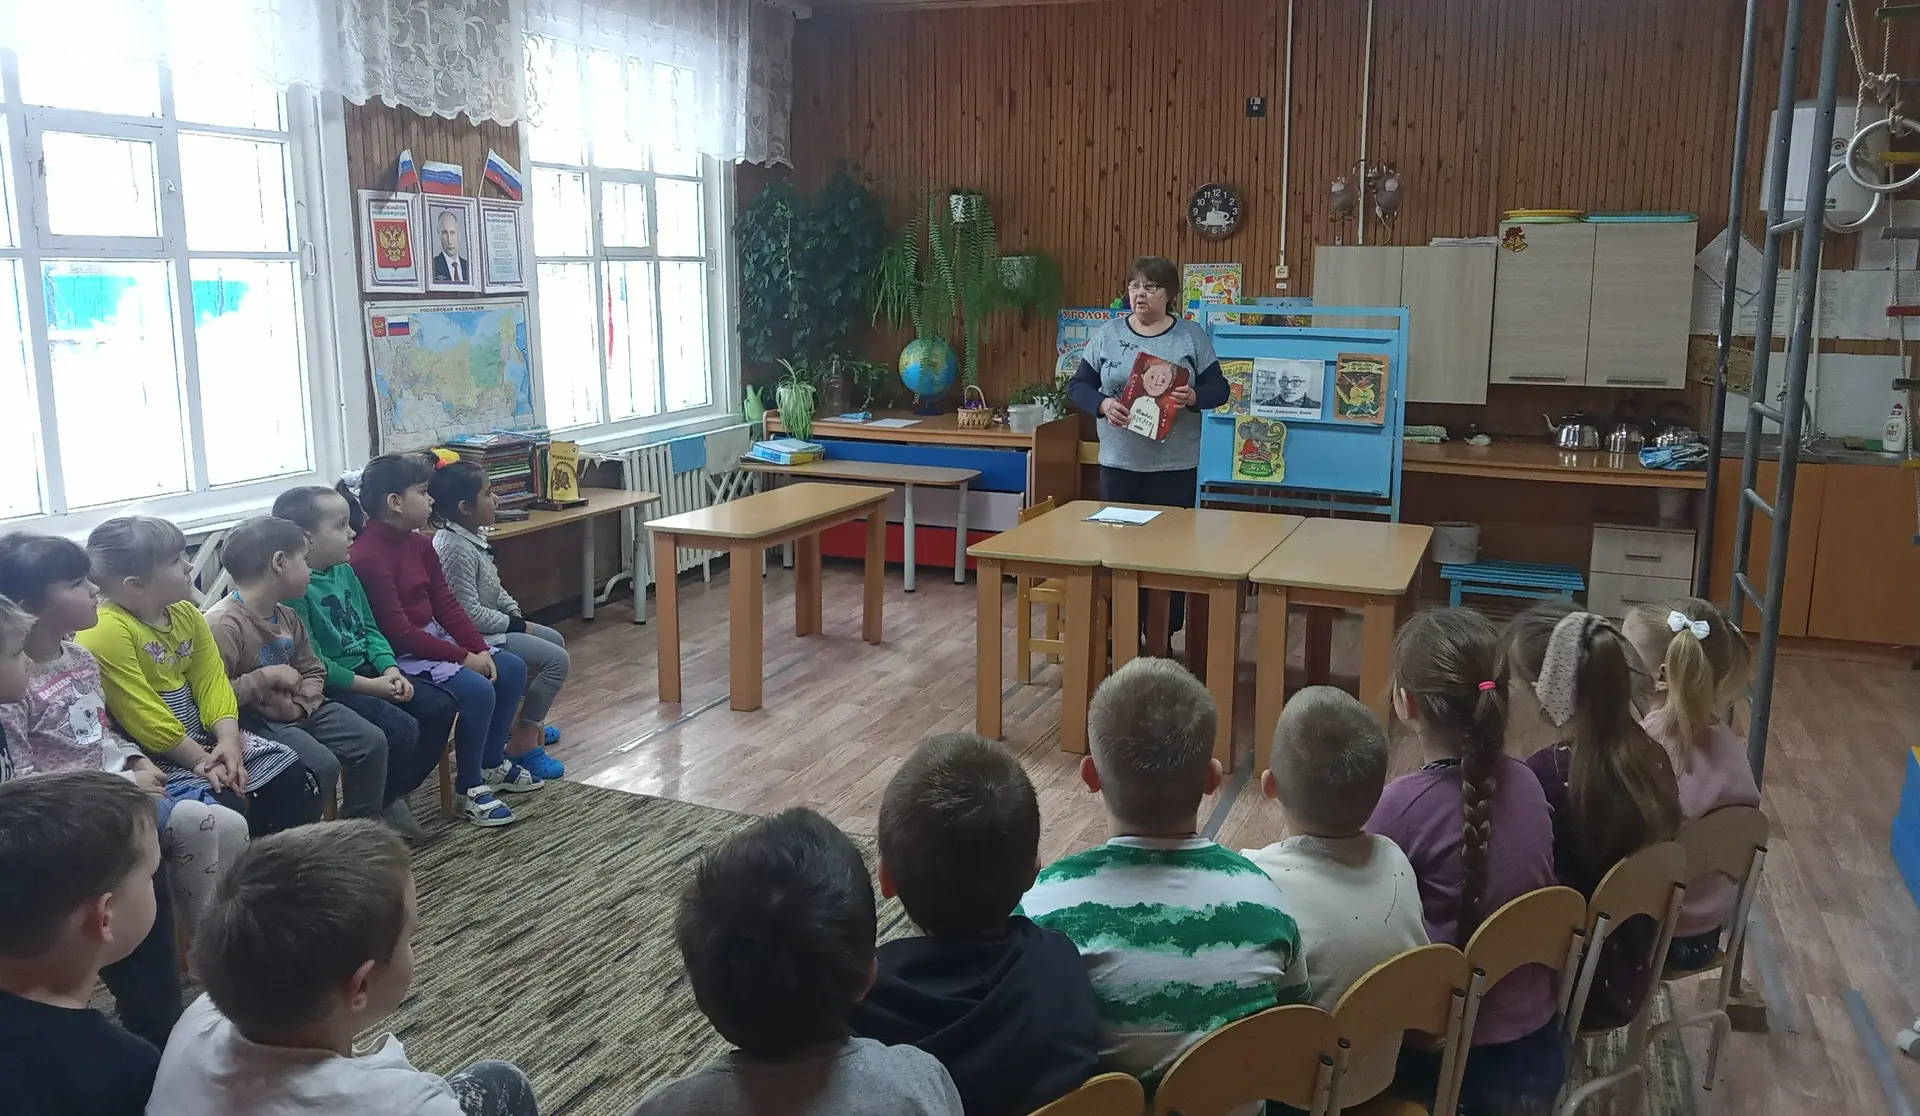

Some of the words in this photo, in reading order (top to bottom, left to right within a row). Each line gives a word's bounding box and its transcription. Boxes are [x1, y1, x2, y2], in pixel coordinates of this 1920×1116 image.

[1204, 191, 1211, 199] 11
[1212, 188, 1221, 197] 12
[1197, 198, 1206, 206] 10
[1229, 197, 1235, 206] 2
[1192, 207, 1199, 216] 9
[1232, 207, 1238, 216] 3
[1196, 216, 1201, 225] 8
[1211, 226, 1217, 235] 6
[1062, 310, 1111, 320] УГОЛОК
